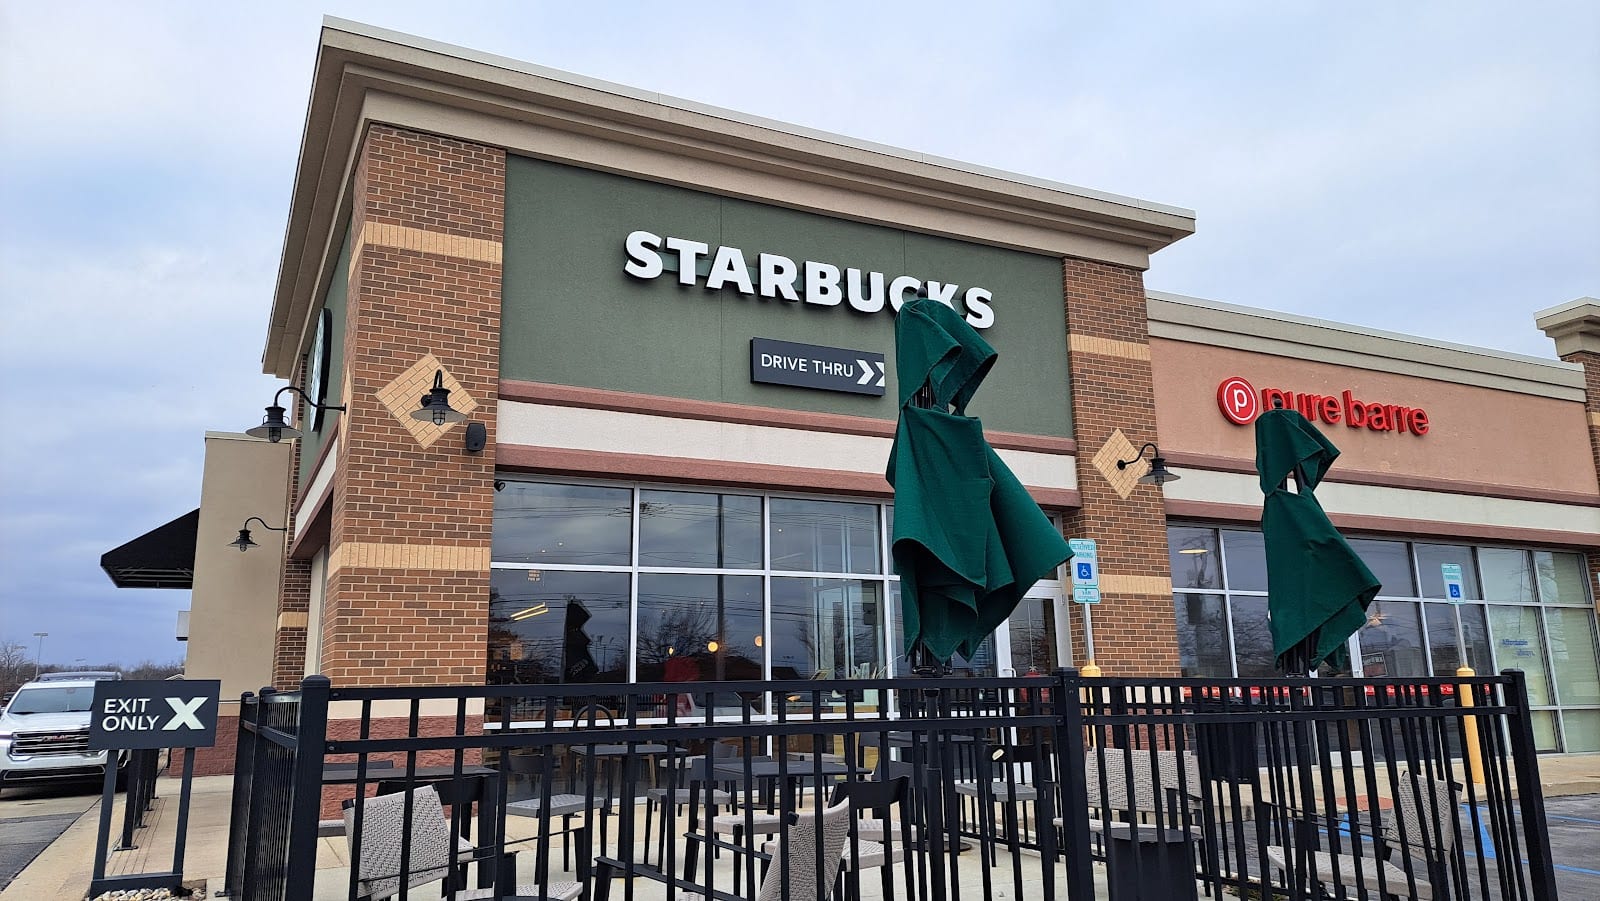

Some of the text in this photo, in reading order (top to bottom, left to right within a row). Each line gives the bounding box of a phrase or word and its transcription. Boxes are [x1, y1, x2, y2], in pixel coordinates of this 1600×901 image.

[624, 230, 995, 329] STARBUCKS
[761, 353, 854, 378] DRIVE THRU
[1342, 389, 1429, 436] barre
[104, 698, 151, 714] EXIT
[102, 715, 160, 732] ONLY
